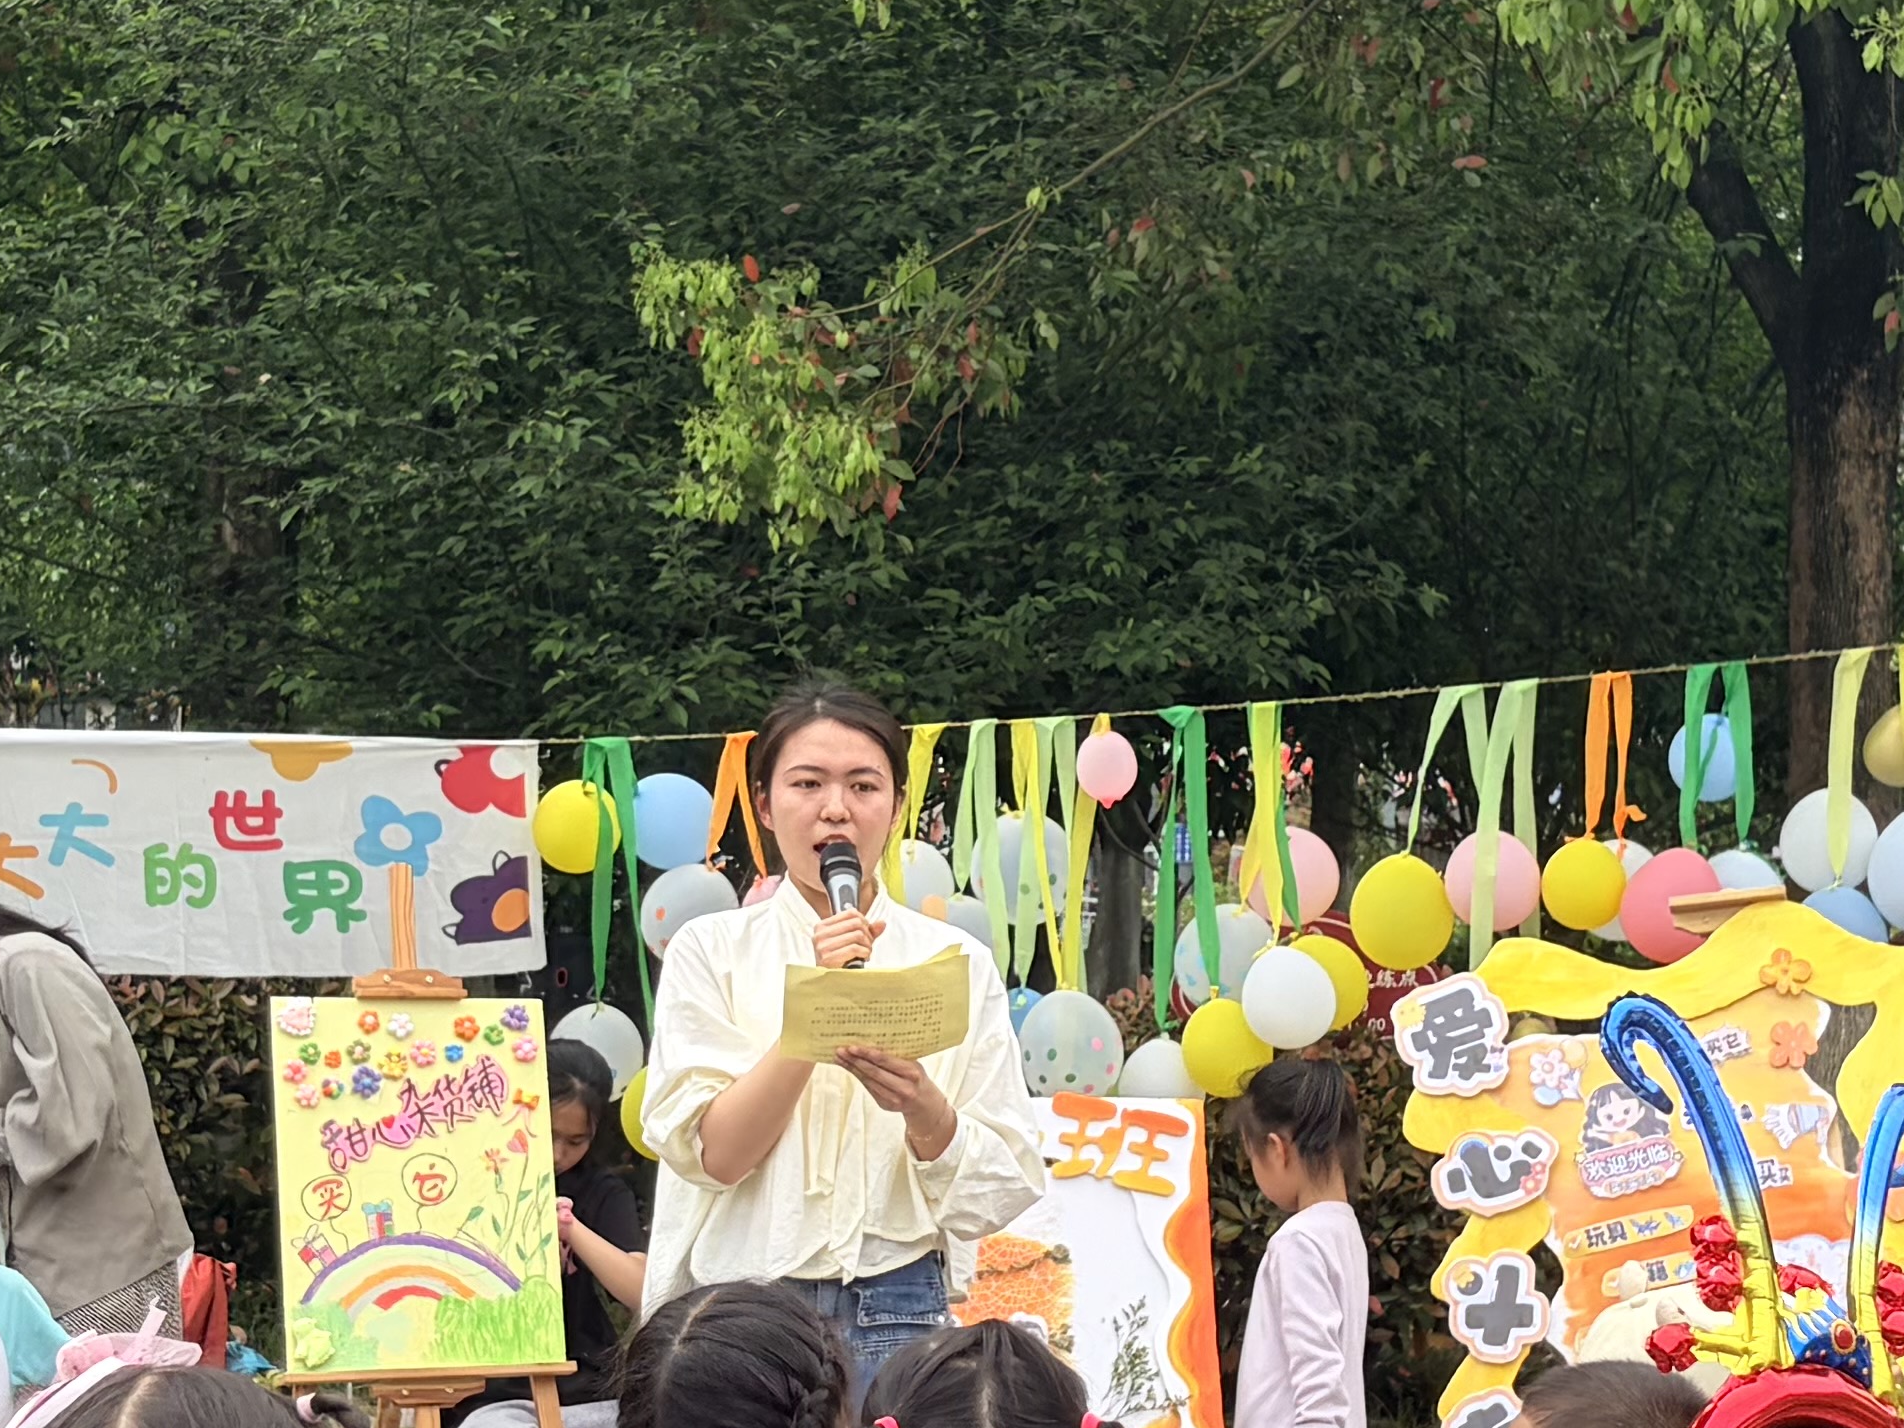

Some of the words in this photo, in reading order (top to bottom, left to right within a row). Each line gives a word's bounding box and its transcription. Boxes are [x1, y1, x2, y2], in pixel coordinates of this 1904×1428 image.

[1366, 969, 1419, 989] 练点
[1584, 1142, 1671, 1182] 欢迎光临
[1585, 1220, 1628, 1248] 玩具
